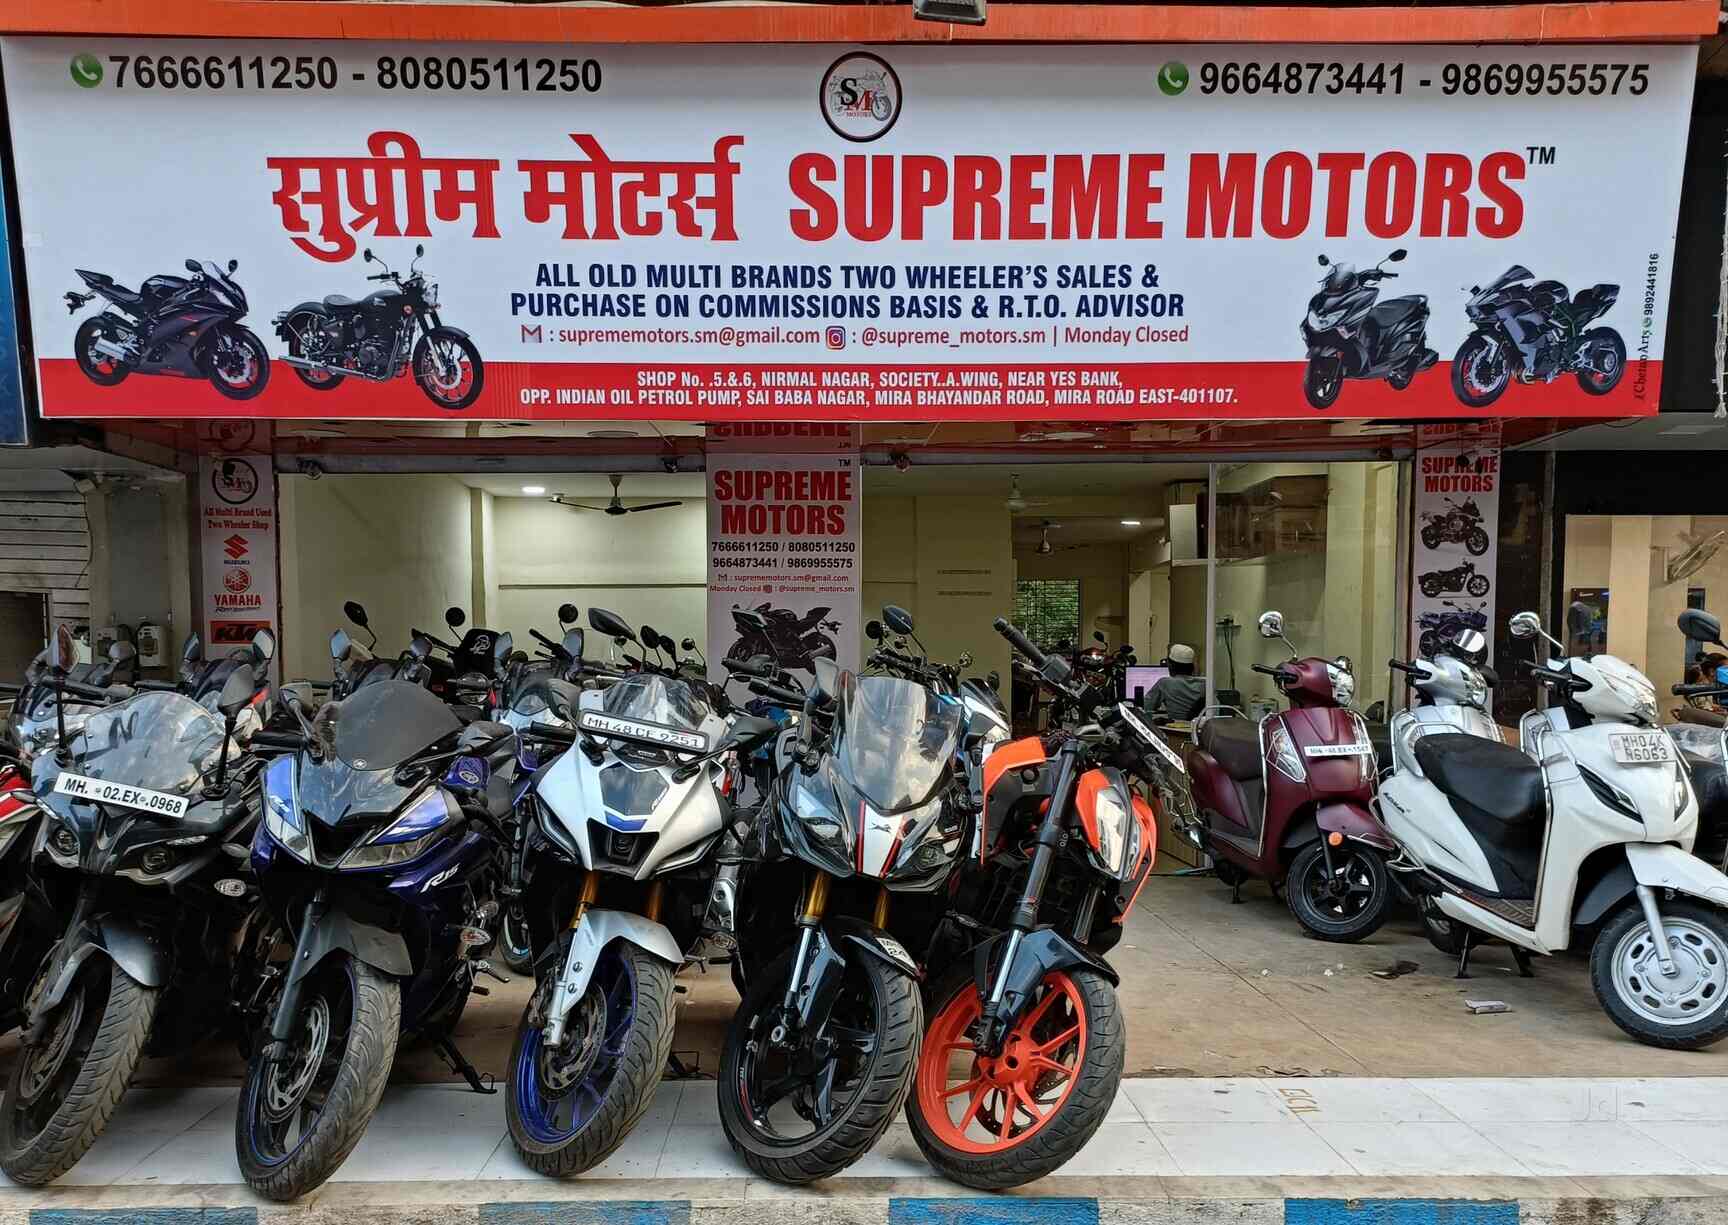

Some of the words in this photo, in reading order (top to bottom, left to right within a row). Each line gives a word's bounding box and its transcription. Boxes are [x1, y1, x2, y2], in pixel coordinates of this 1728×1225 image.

[109, 56, 337, 88] 7666611250
[377, 57, 601, 92] 8080511250
[1200, 62, 1404, 95] 9664873441
[1442, 63, 1649, 96] 9869955575
[267, 131, 501, 262] सुप्रीम
[517, 134, 744, 241] मोटर्स
[789, 152, 1165, 241] SUPREME
[1185, 151, 1526, 239] MOTORS
[1526, 146, 1555, 164] TM
[536, 264, 580, 287] ALL
[589, 264, 636, 287] OLD
[647, 265, 721, 288] MULTI
[731, 265, 832, 288] BRANDS
[841, 265, 895, 289] TWO
[905, 265, 1047, 289] WHEELER’S
[1057, 264, 1131, 288] SALES
[1141, 264, 1159, 288] &
[1644, 253, 1659, 316] 9892441816
[511, 293, 646, 317] PURCHASE
[656, 294, 689, 317] ON
[699, 294, 880, 318] COMMISSIONS
[890, 295, 961, 318] BASIS
[971, 295, 989, 318] &
[999, 295, 1066, 318] R.T.O.
[1075, 294, 1183, 317] ADVISOR
[559, 325, 820, 346] suprememotors.sm@gmail.com
[862, 327, 1045, 348] @supreme_motors.sm
[1065, 326, 1130, 347] Monday
[1135, 326, 1189, 343] Closed
[637, 371, 677, 386] SHOP
[681, 372, 704, 386] No.
[761, 372, 816, 387] NIRMAL
[822, 372, 875, 389] NAGAR,
[1008, 372, 1045, 386] NEAR
[1050, 371, 1076, 386] YES
[1081, 371, 1123, 389] BANK,
[520, 390, 552, 405] OPP.
[556, 390, 606, 405] INDIAN
[610, 390, 634, 405] OIL
[638, 390, 694, 405] PETROL
[698, 390, 743, 408] PUMP,
[746, 390, 770, 405] SAI
[774, 390, 813, 405] BABA
[817, 390, 870, 408] NAGAR,
[876, 390, 912, 405] MIRA
[917, 390, 1001, 405] BHAYANDAR
[1006, 390, 1050, 408] ROAD,
[1054, 389, 1092, 405] MIRA
[1096, 389, 1135, 404] ROAD
[1139, 388, 1239, 404] EAST-401107.
[714, 470, 851, 501] SUPREME
[1425, 475, 1493, 492] MOTORS
[721, 504, 845, 535] MOTORS
[711, 542, 778, 552] 7666611250
[788, 542, 855, 552] 8080511250
[713, 558, 777, 568] 9664873441
[787, 558, 853, 568] 9869955575
[214, 594, 261, 606] YAMAHA
